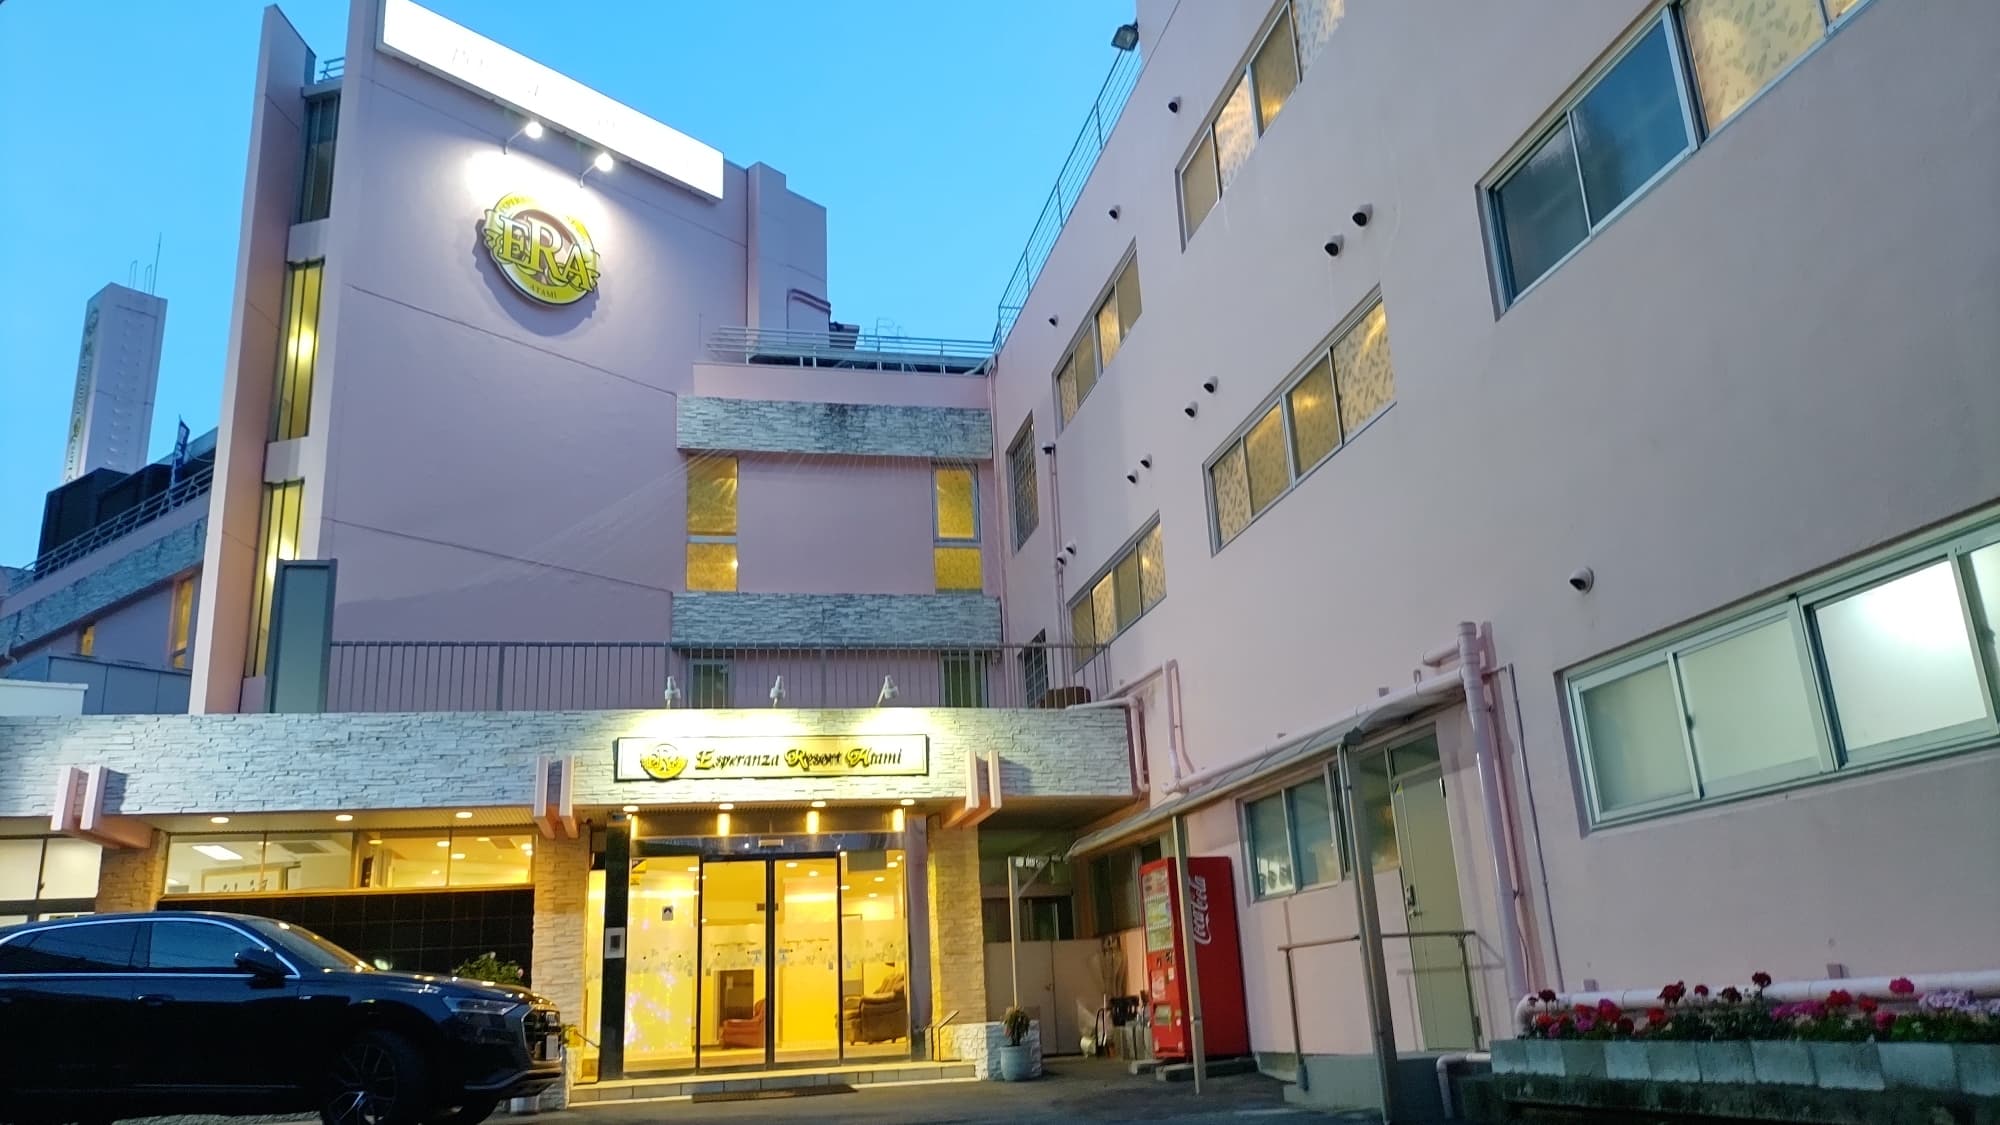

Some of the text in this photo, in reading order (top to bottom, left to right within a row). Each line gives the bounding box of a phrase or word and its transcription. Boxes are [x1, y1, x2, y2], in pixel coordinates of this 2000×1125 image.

[499, 215, 593, 292] ERA
[695, 748, 902, 771] Esperanza Resort Atami
